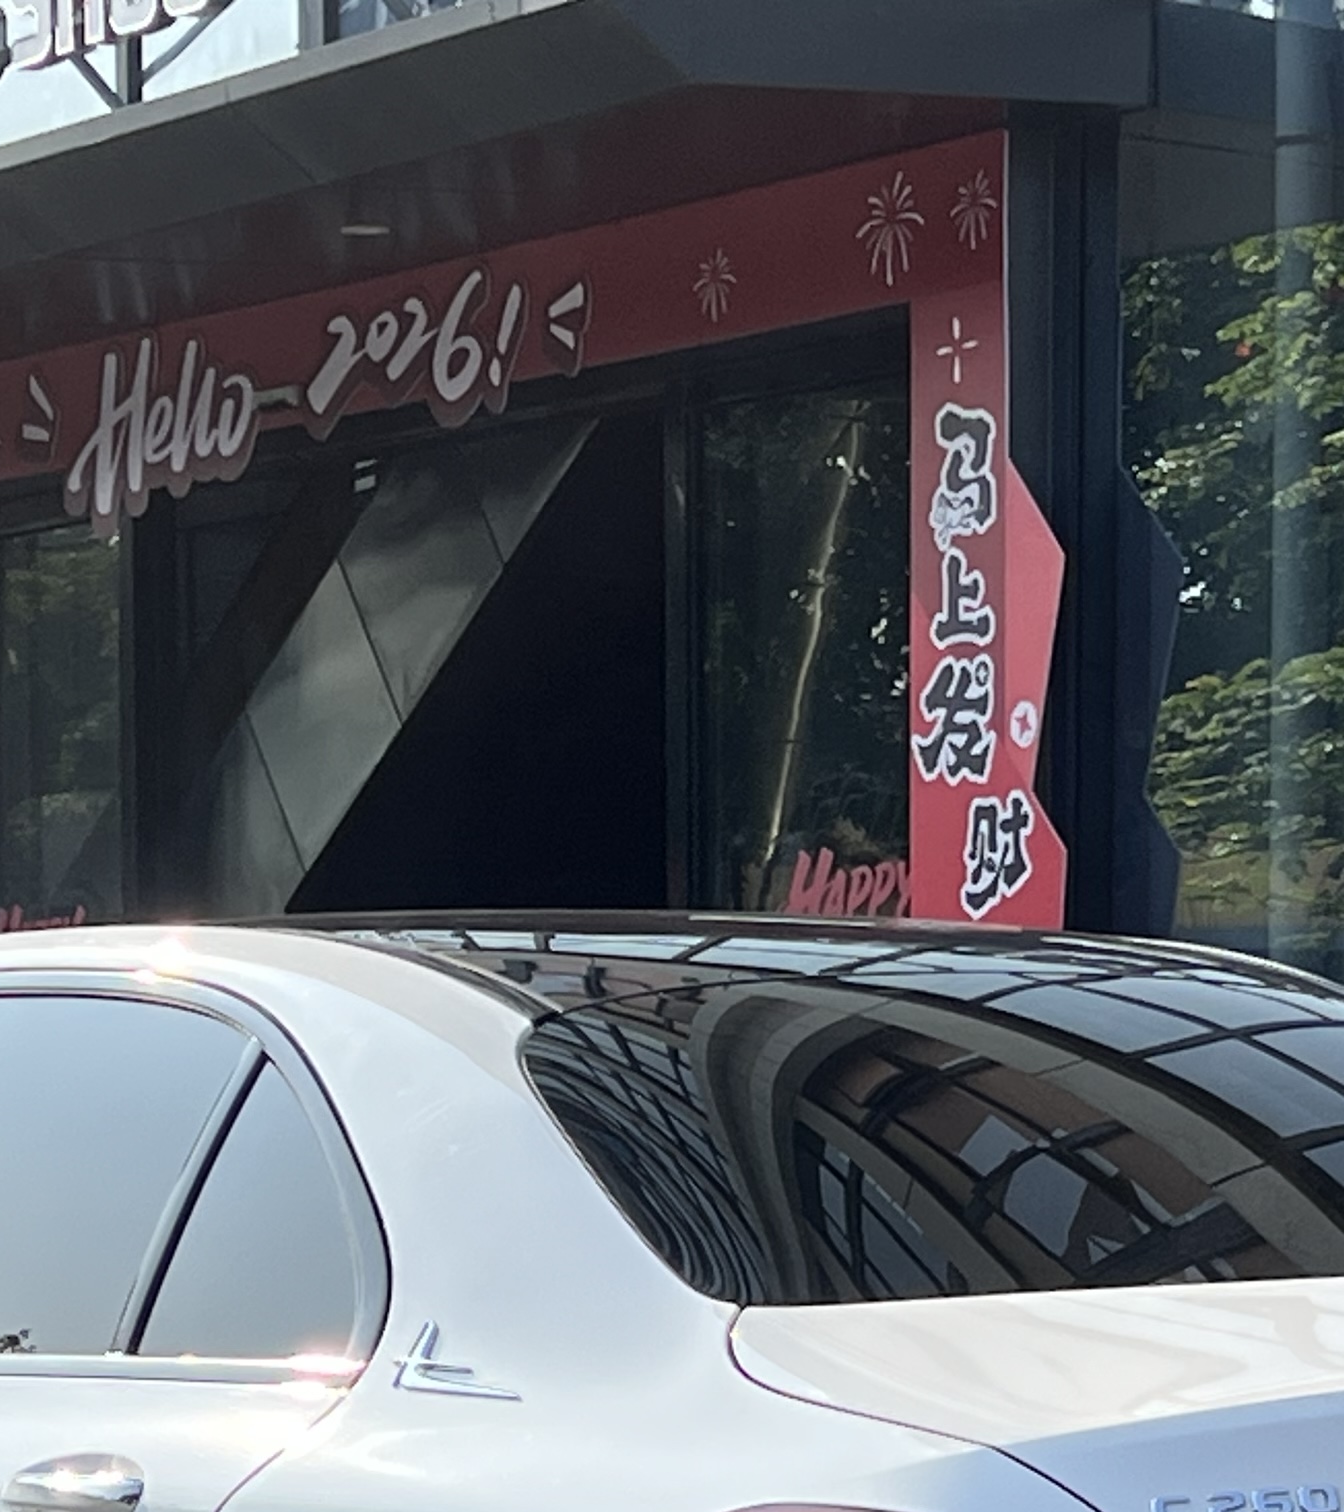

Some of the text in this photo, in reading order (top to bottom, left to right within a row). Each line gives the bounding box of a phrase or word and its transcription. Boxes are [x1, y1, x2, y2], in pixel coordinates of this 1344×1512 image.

[67, 269, 522, 515] Hello 2026!
[911, 402, 1032, 919] 马上发财
